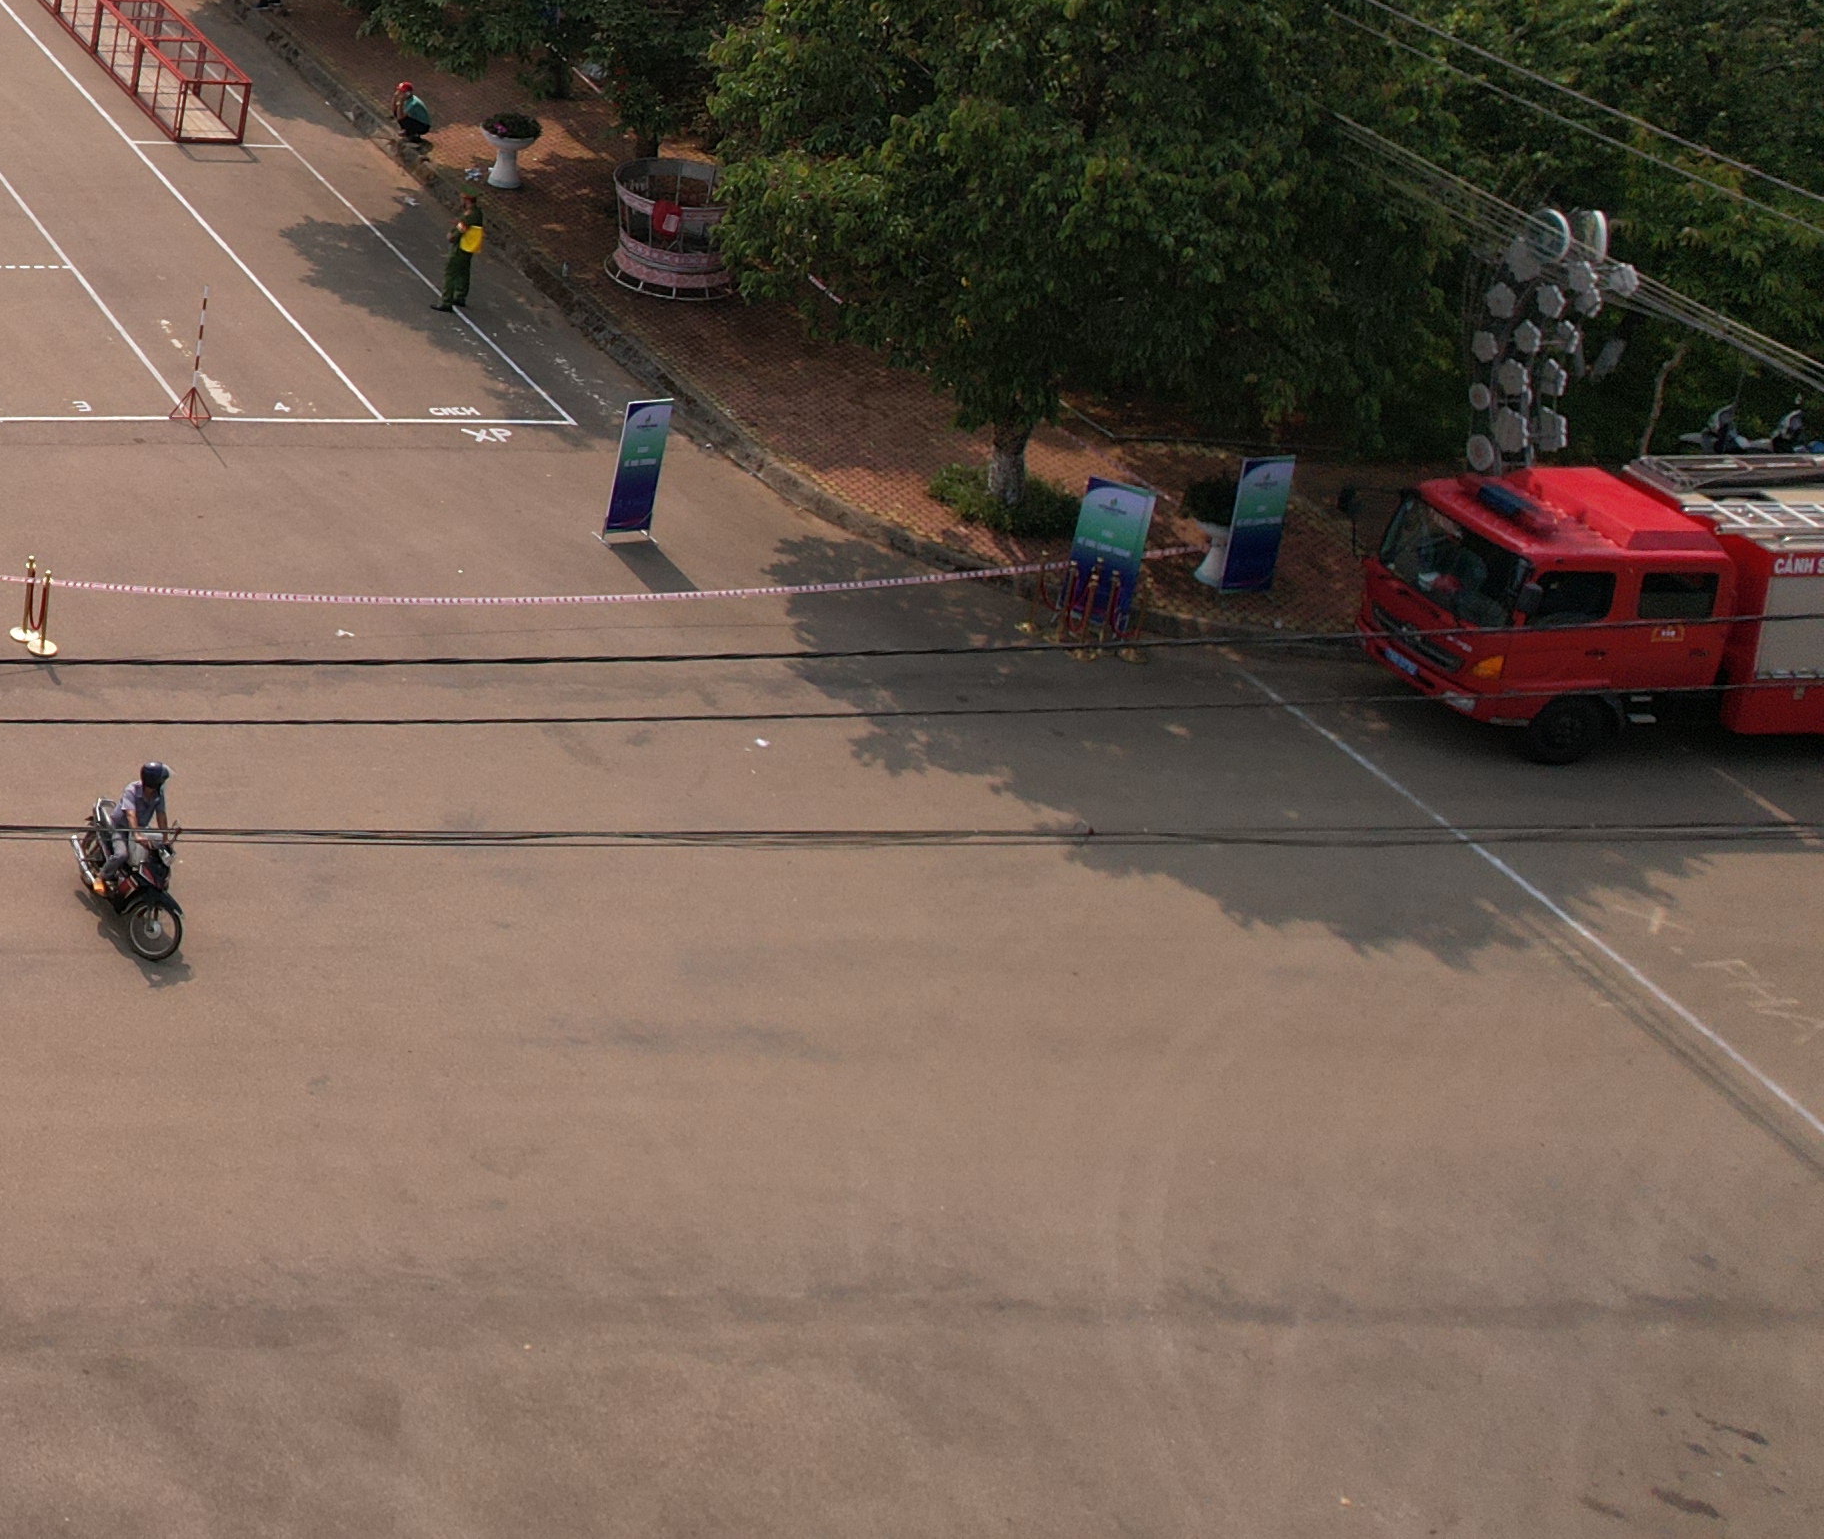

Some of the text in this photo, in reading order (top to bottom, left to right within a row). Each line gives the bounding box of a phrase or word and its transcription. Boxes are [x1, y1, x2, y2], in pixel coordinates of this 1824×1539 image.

[72, 400, 92, 411] 3
[273, 402, 291, 412] 4
[461, 428, 512, 442] XP
[1774, 553, 1815, 574] CẢNH
